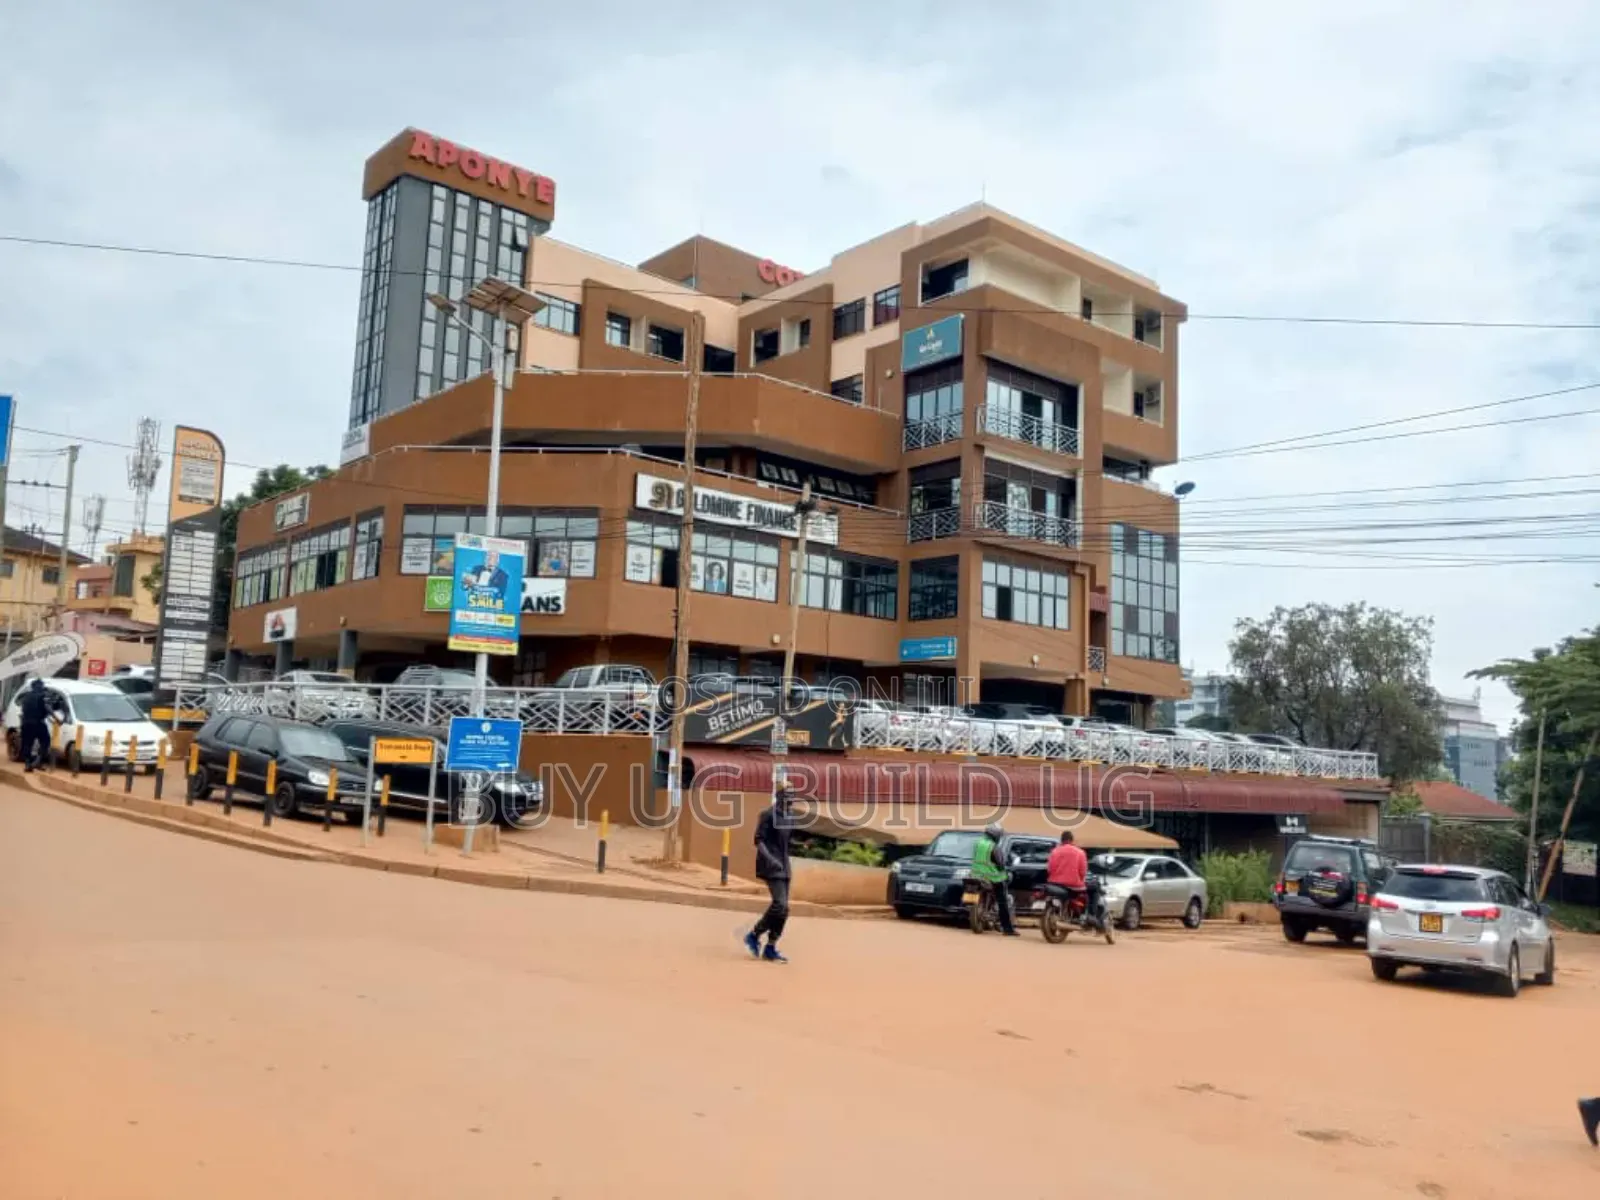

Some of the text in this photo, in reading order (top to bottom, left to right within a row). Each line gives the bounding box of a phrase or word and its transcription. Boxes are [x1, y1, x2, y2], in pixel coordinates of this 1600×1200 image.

[409, 131, 556, 204] APONYE
[758, 258, 804, 286] CO
[676, 488, 743, 520] GLDMINE
